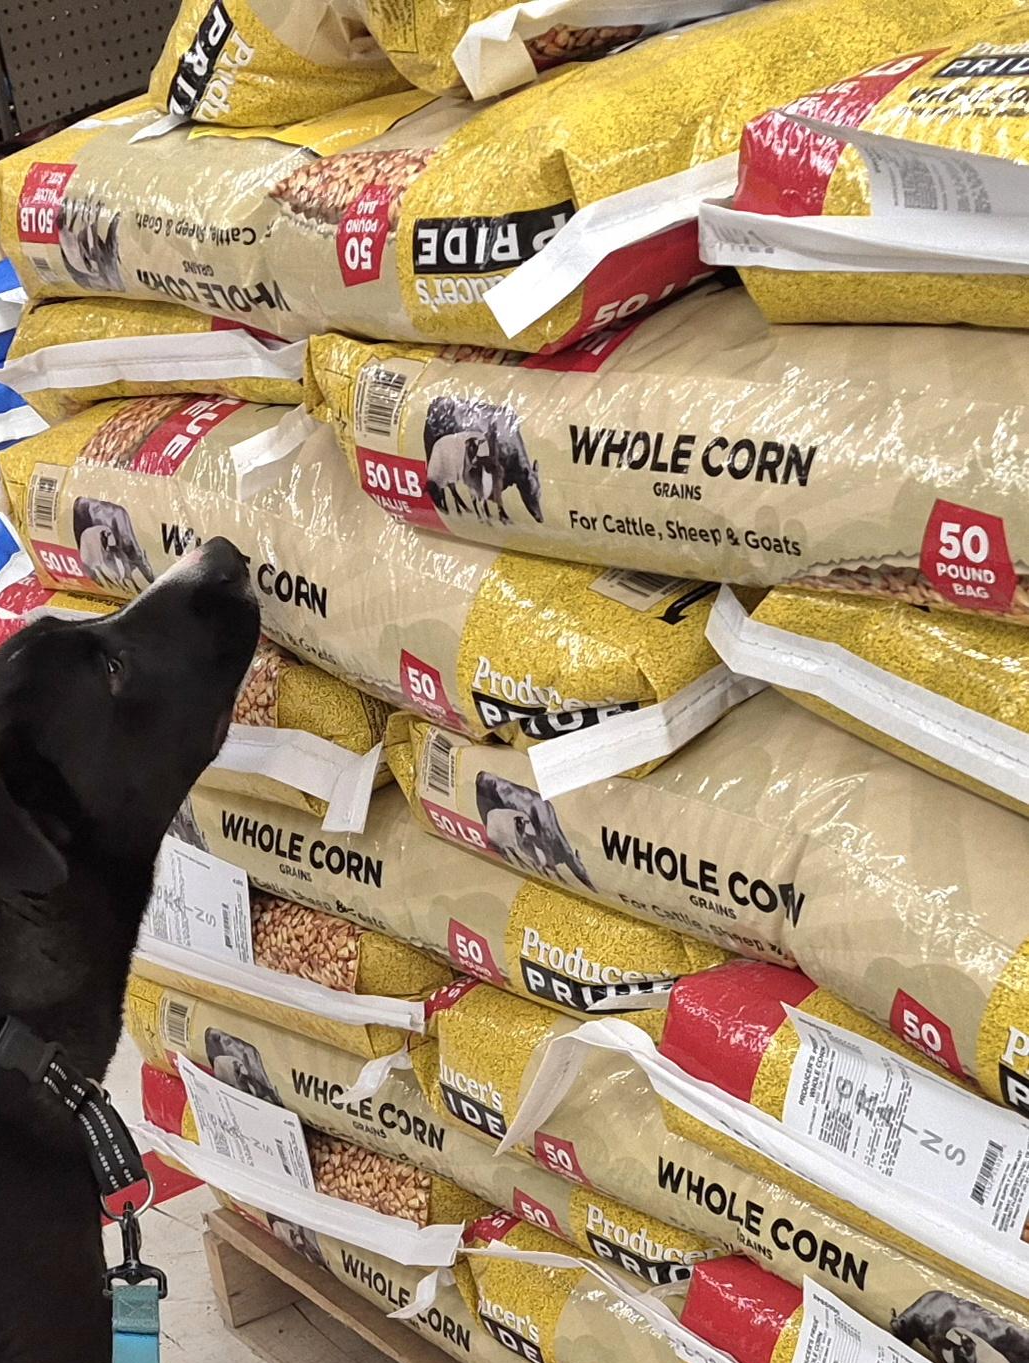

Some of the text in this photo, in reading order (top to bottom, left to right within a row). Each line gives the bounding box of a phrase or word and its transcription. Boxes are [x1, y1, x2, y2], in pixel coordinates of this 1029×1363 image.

[168, 4, 233, 117] PRI
[20, 207, 54, 233] 50 LB
[344, 217, 379, 233] POUND
[182, 260, 215, 278] GRAINS
[344, 235, 374, 271] 50
[585, 292, 650, 330] 50
[569, 424, 819, 487] WHOLE CORN
[365, 460, 424, 498] 50 LB
[652, 481, 702, 501] GRAINS
[569, 510, 802, 557] For Cattle, Sheep & Goats
[938, 521, 990, 563] 50
[39, 550, 84, 577] 50 LB
[936, 562, 997, 585] POUND
[258, 563, 328, 618] CORN
[951, 582, 991, 600] BAG
[407, 666, 436, 701] 50
[429, 809, 488, 848] 50 LB
[222, 810, 383, 888] WHOLE CORN
[601, 825, 719, 897] WHOLE
[279, 863, 313, 882] GRAINS
[689, 895, 738, 921] GRAINS
[455, 933, 483, 965] 50
[903, 1008, 942, 1053] 50
[440, 1060, 503, 1112] ucer's
[808, 1069, 821, 1098] WHOLE
[378, 1103, 445, 1152] CORN
[543, 1140, 573, 1171] 50
[521, 1201, 550, 1228] 50
[657, 1155, 869, 1291] WHOLE CORN
[341, 1249, 411, 1309] WHOLE
[593, 1239, 696, 1285] PRID
[479, 1294, 540, 1345] ucer's
